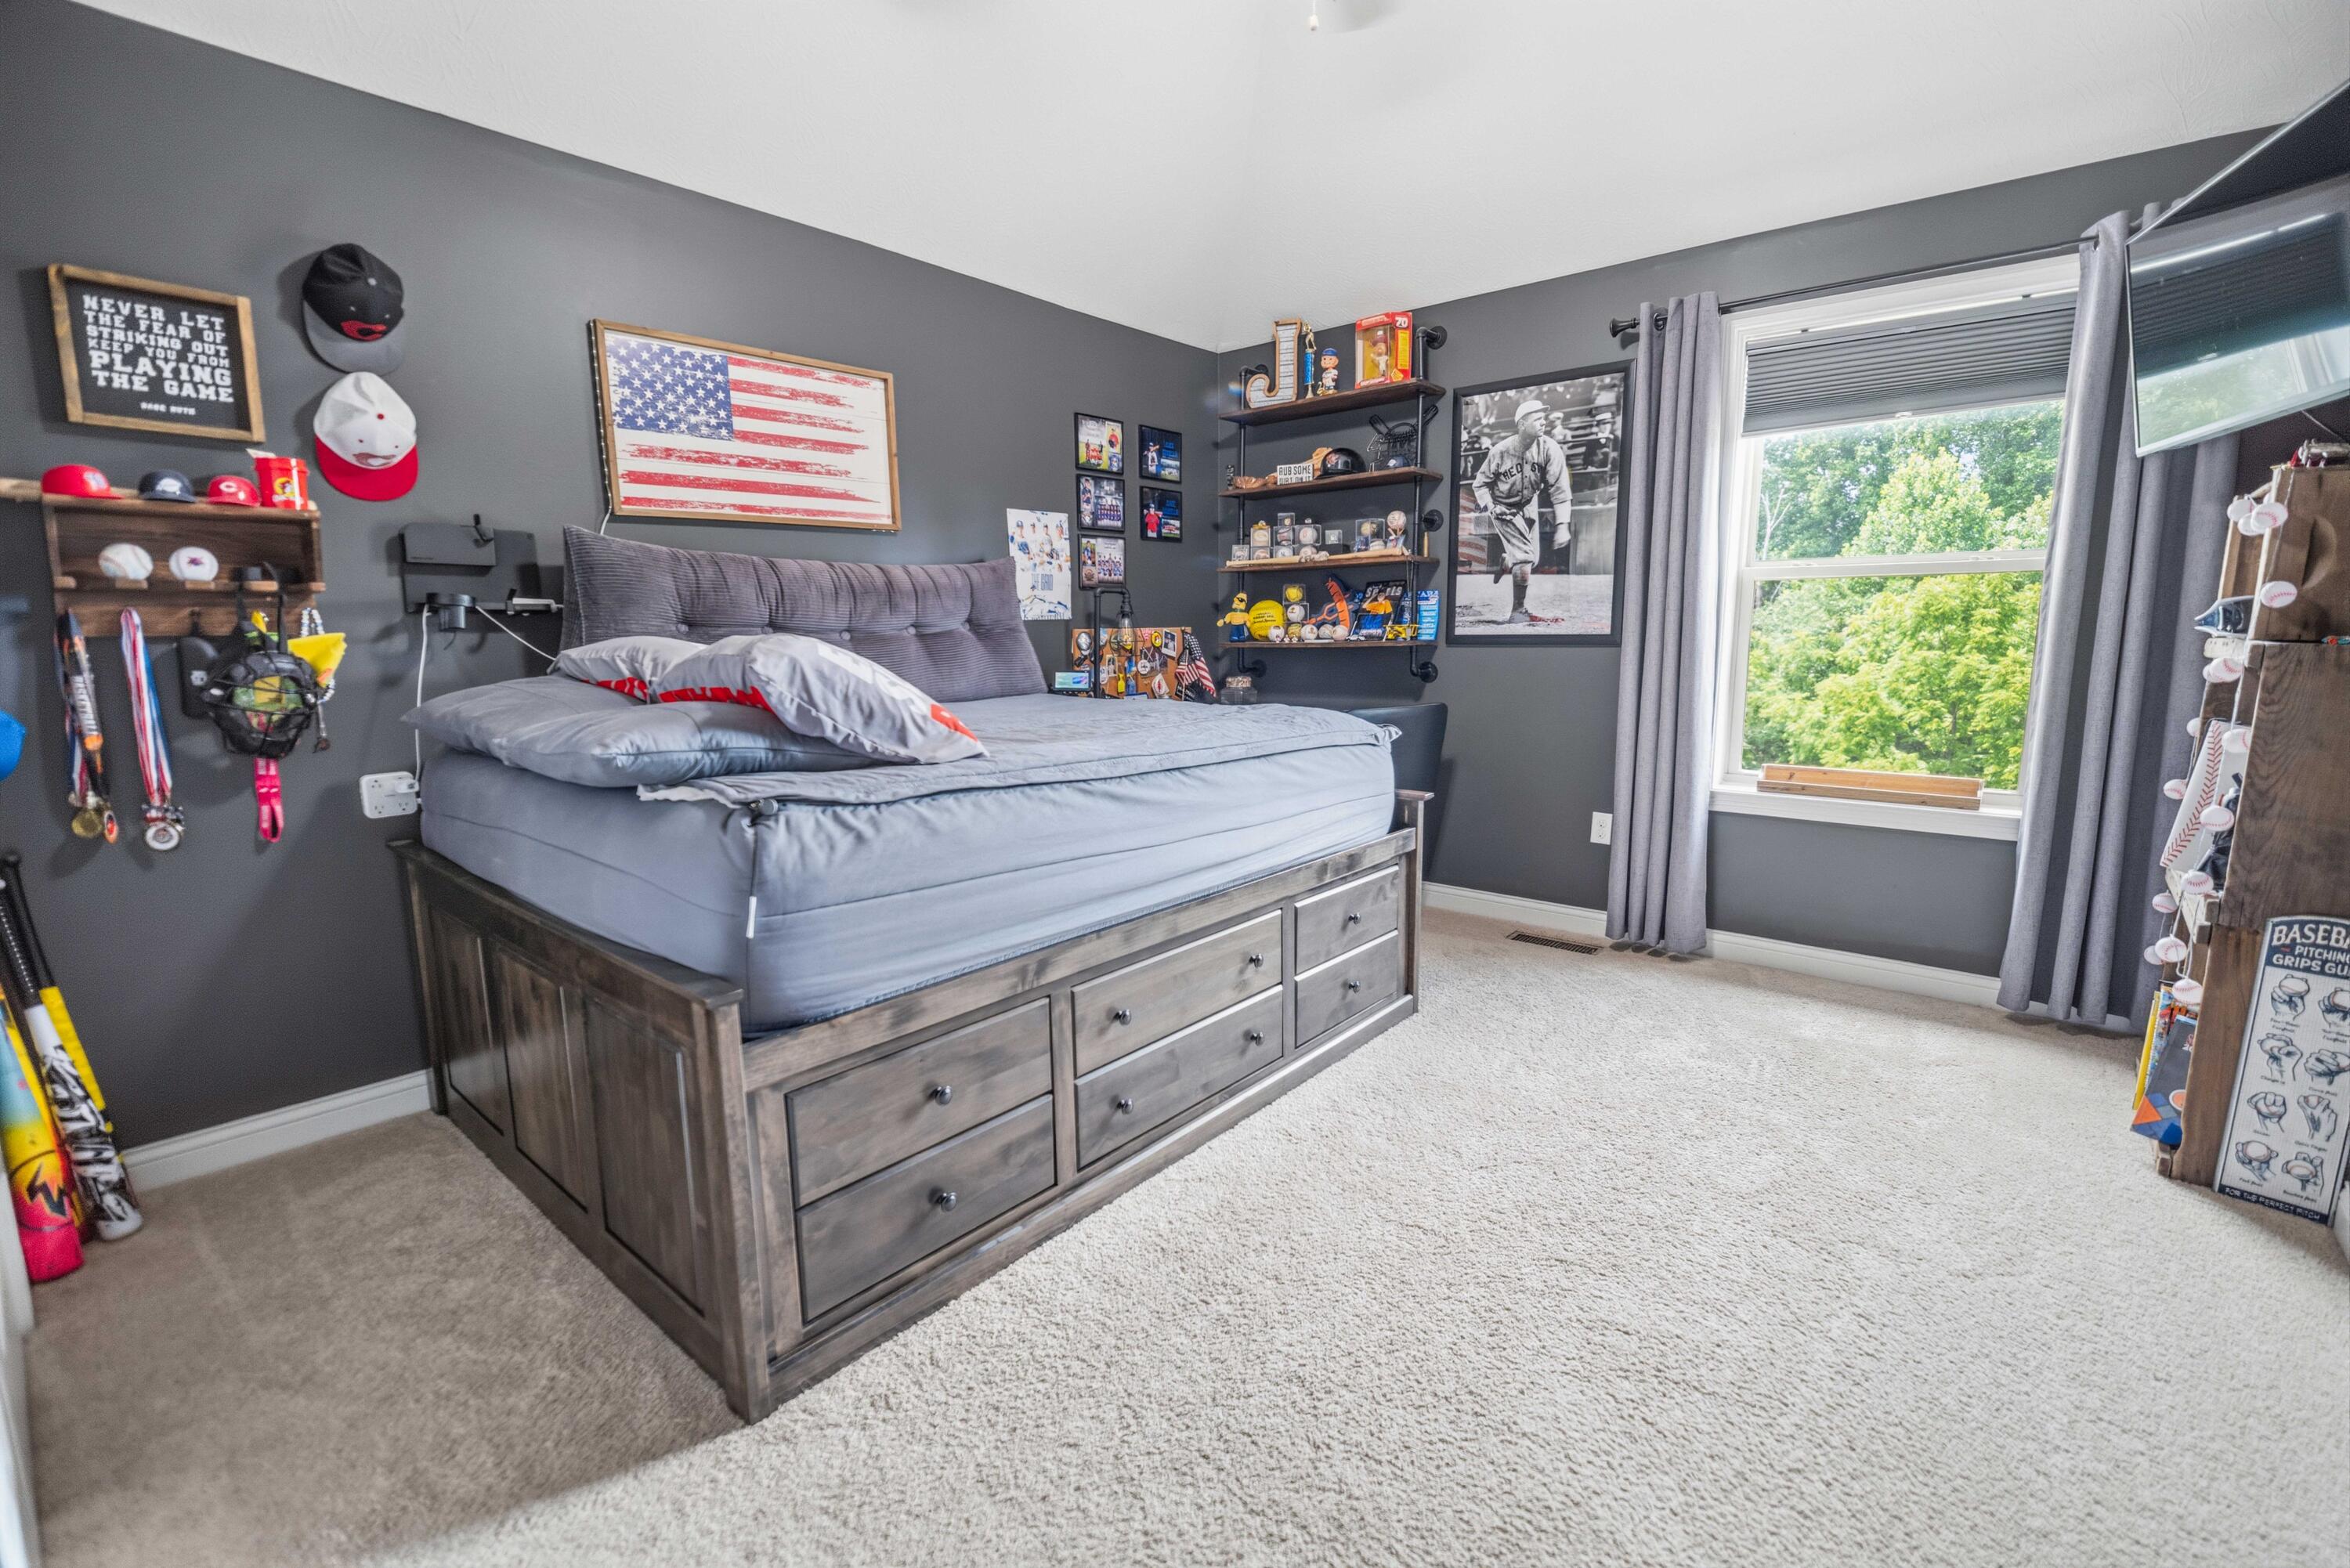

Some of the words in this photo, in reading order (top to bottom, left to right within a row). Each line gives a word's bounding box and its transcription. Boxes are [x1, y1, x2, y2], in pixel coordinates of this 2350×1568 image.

[83, 294, 165, 322] NEVER
[180, 312, 224, 331] LET
[84, 310, 125, 328] THE
[139, 320, 191, 339] FEAR
[203, 331, 226, 344] OF
[86, 325, 183, 350] STRIKING
[191, 341, 229, 357] OUT
[88, 338, 134, 353] KEEP
[146, 347, 177, 359] YOU
[187, 352, 230, 368] FROM
[89, 350, 232, 386] PLAYING
[92, 370, 149, 392] THE
[164, 379, 234, 403] GAME
[1279, 466, 1292, 475] RUB
[1293, 464, 1311, 475] SOME
[1502, 462, 1523, 480] RED
[2272, 953, 2322, 971] GRIPS
[2225, 1187, 2241, 1198] FOR
[2243, 1192, 2257, 1202] THE
[2259, 1196, 2294, 1211] PERFECT
[2296, 1207, 2320, 1219] PITCH
